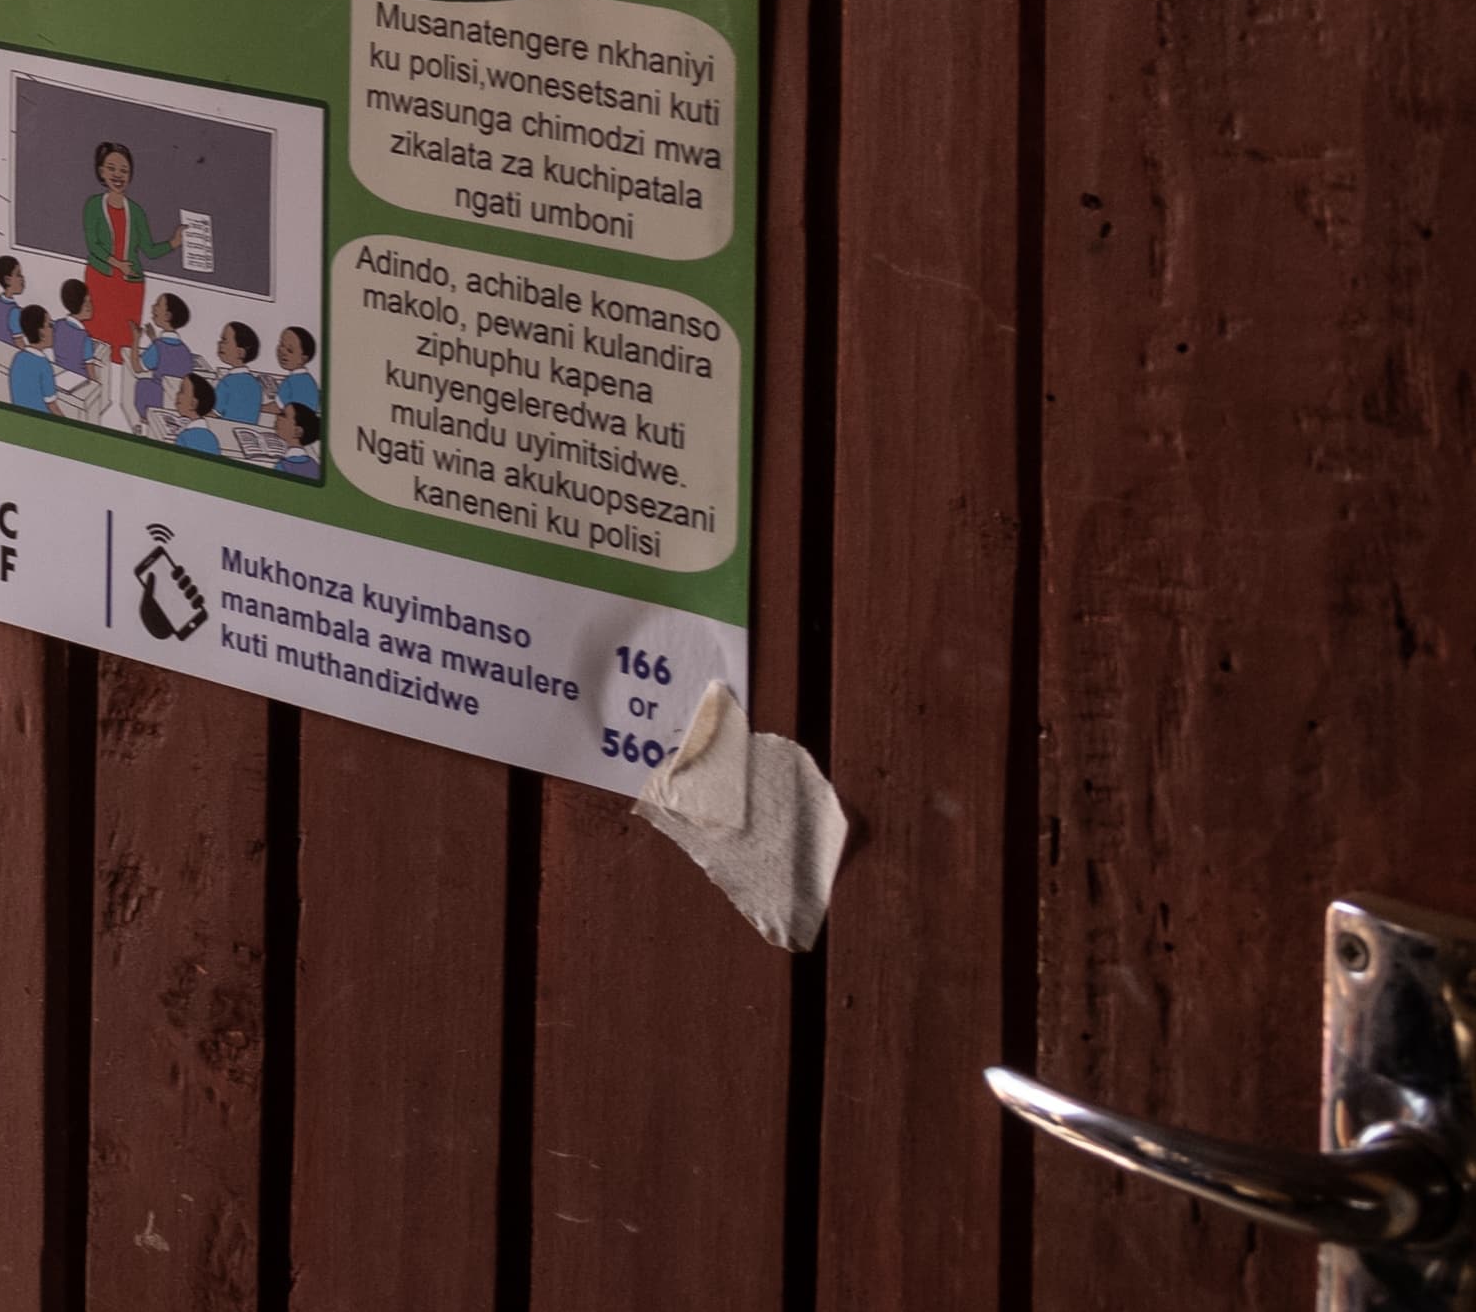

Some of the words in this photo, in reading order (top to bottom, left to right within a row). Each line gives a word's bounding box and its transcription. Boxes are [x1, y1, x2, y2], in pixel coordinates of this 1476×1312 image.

[371, 42, 400, 71] ku
[670, 92, 719, 126] kuti
[377, 2, 589, 60] Musanatengere
[598, 40, 713, 85] nkhaniyi
[367, 89, 511, 136] mwasunga
[522, 111, 645, 156] chimodzi
[655, 140, 721, 169] mwa
[390, 131, 492, 170] zikalata
[501, 154, 533, 178] za
[544, 155, 702, 209] kuchipatala
[456, 188, 521, 218] ngati
[531, 202, 633, 239] umboni
[355, 246, 456, 292] Adindo,
[467, 273, 581, 313] achibale
[592, 291, 720, 341] komanso
[364, 289, 466, 331] makolo,
[477, 312, 573, 349] pewani
[584, 326, 712, 379] kulandira
[386, 361, 626, 436] kunyengeleredwa
[636, 414, 685, 449] kuti
[417, 336, 539, 379] ziphuphu
[551, 357, 653, 404] kapena
[357, 426, 424, 465] Ngati
[433, 449, 495, 482] wina
[504, 464, 714, 532] akukuopsezani
[391, 404, 506, 447] mulandu
[517, 432, 686, 488] uyimitsidwe.
[415, 478, 536, 528] kaneneni
[547, 506, 579, 538] ku
[589, 523, 660, 558] polisi
[222, 547, 353, 603] Mukhonza
[363, 583, 531, 648] kuyimbanso
[222, 591, 370, 647] manambala
[379, 634, 431, 664] awa
[442, 650, 579, 700] mwaulere
[222, 624, 267, 658] kuti
[277, 645, 479, 715] muthandizidwe
[615, 645, 672, 686] 166
[601, 726, 680, 769] 560
[628, 696, 659, 720] or
